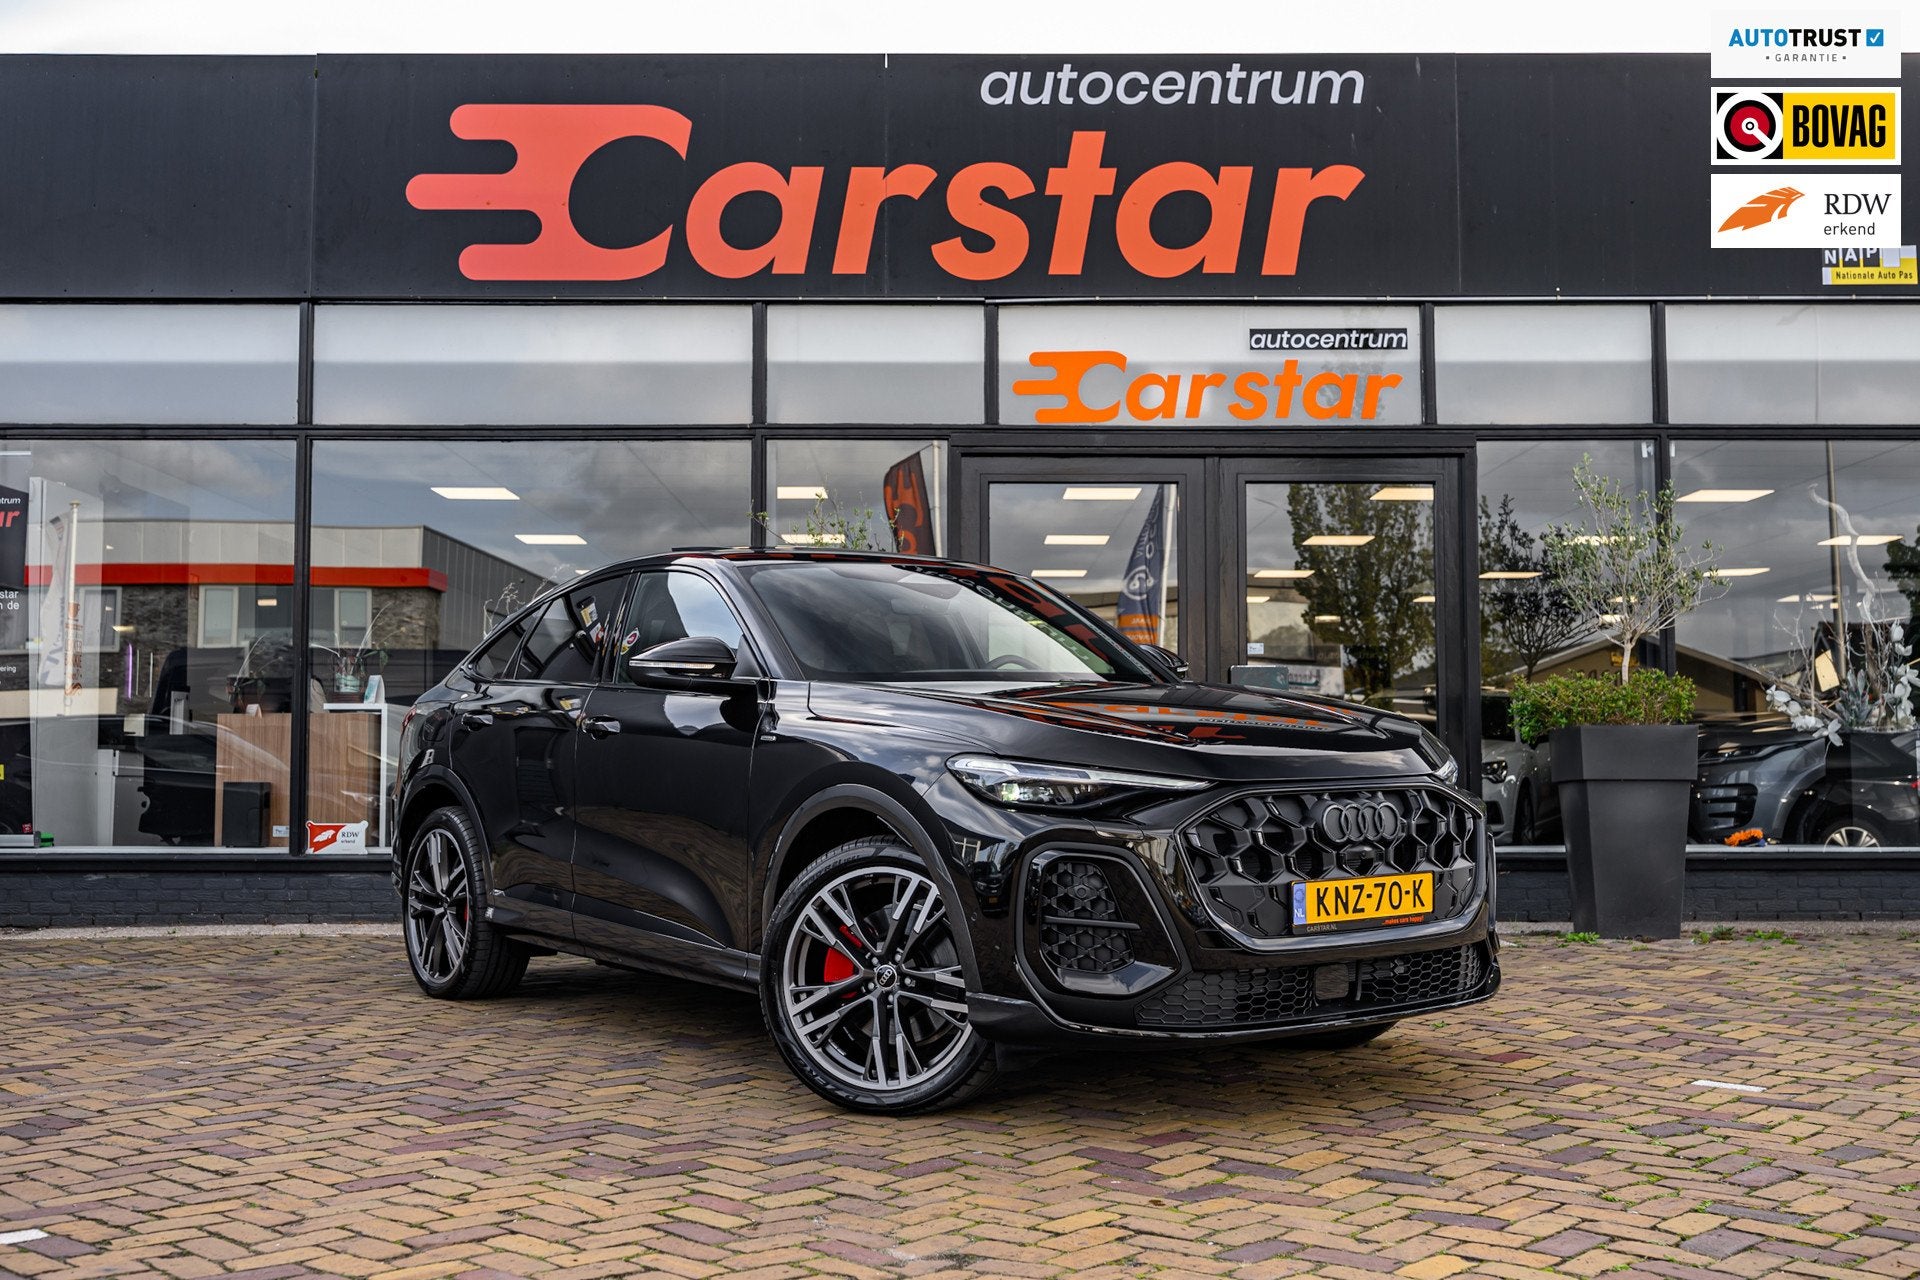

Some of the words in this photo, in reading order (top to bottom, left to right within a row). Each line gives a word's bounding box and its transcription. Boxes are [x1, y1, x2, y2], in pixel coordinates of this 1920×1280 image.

[980, 63, 1365, 105] autocentrum
[405, 104, 1366, 281] Carstar
[1824, 248, 1878, 265] NAP
[1835, 271, 1875, 279] Nationale
[1878, 271, 1896, 279] Auto
[1899, 271, 1913, 279] Pas
[1250, 330, 1408, 349] autocentrum
[1012, 350, 1403, 424] Carstar
[7, 601, 20, 610] de
[1316, 879, 1425, 917] KNZ-70-K
[1294, 908, 1305, 918] NL
